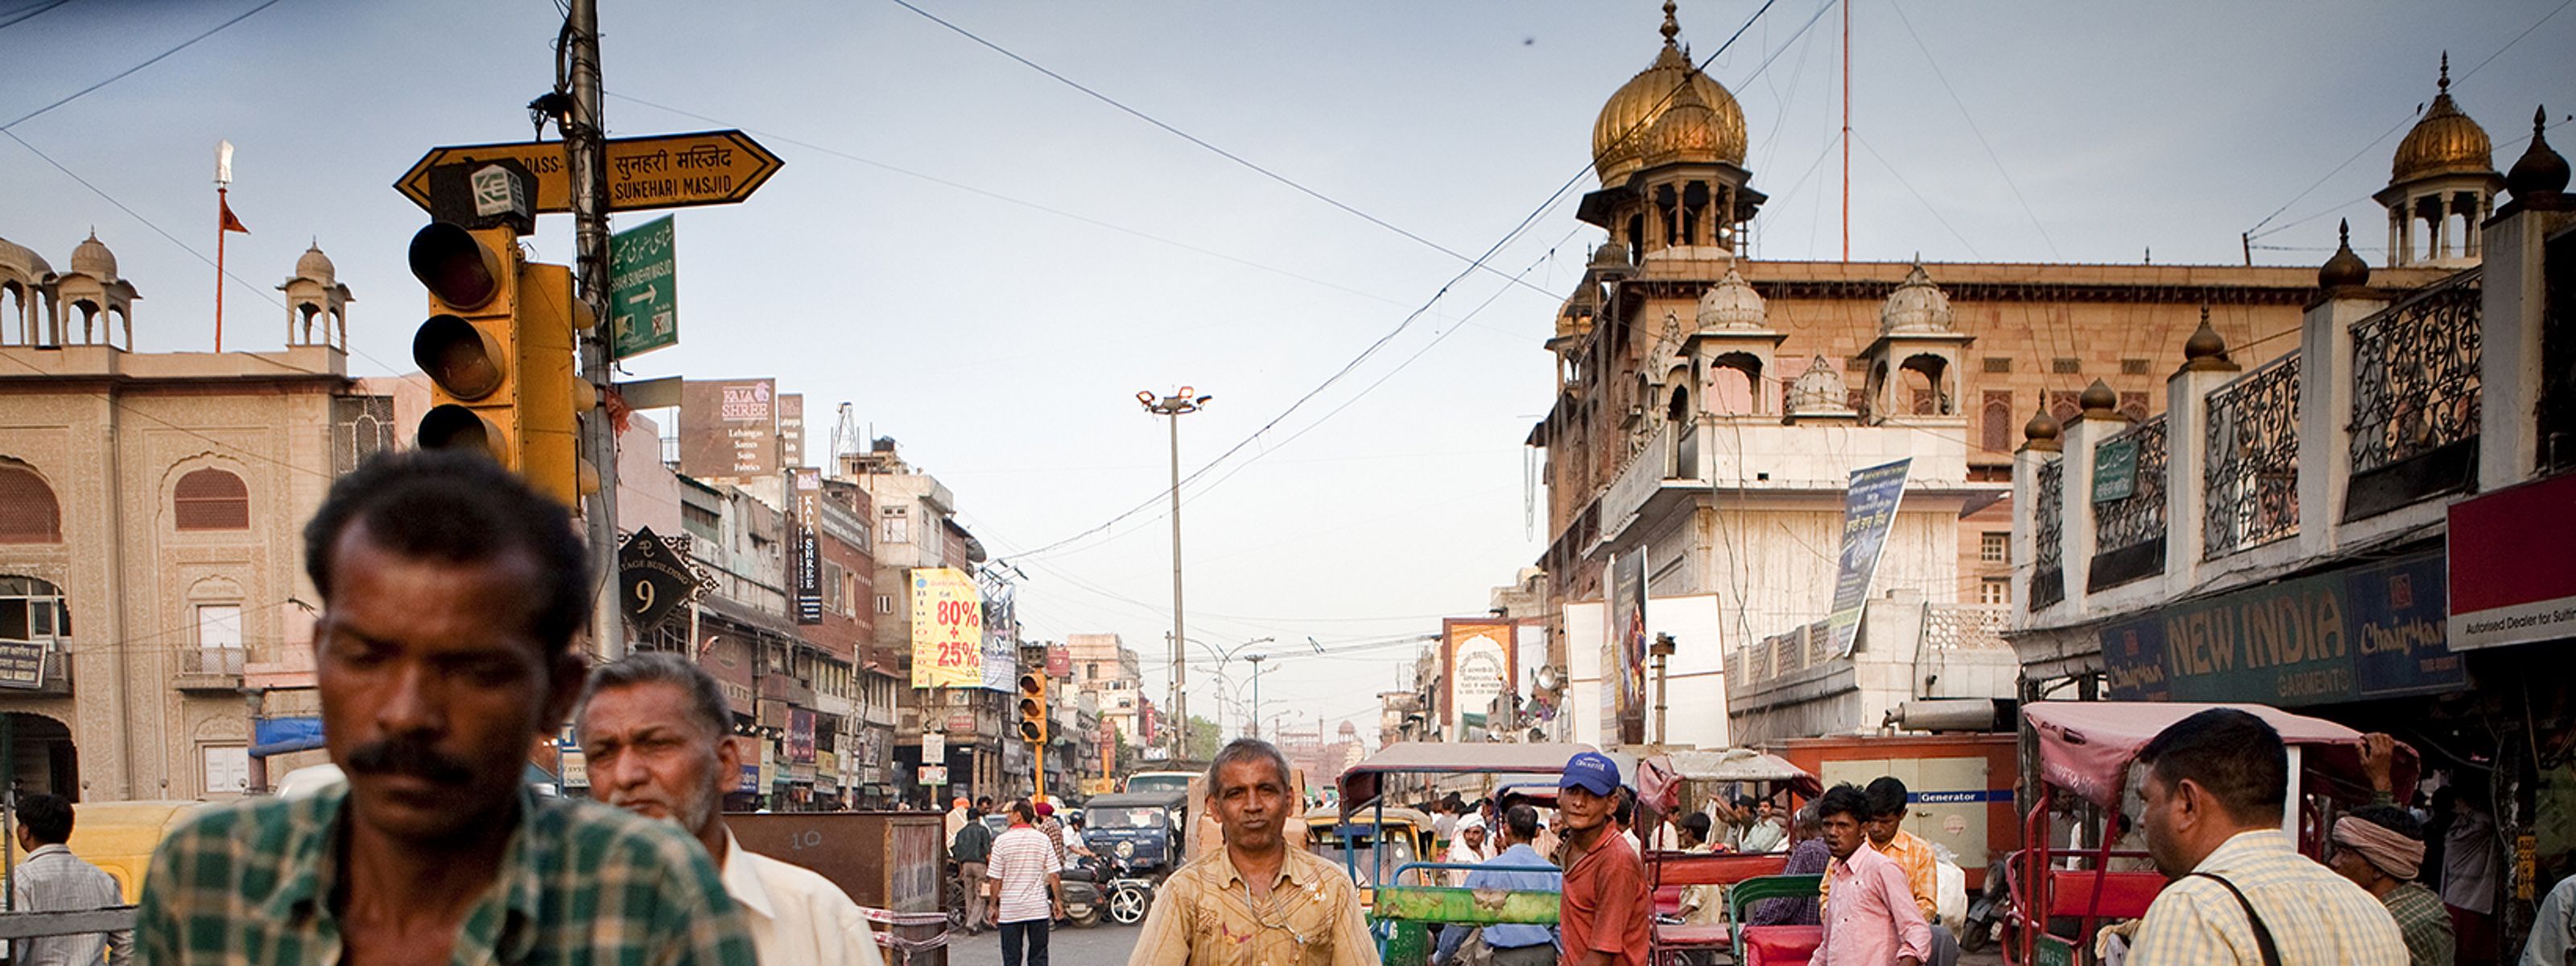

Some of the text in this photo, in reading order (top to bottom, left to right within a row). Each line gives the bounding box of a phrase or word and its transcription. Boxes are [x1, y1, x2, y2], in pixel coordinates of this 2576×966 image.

[615, 149, 668, 180] सुनहरी
[615, 175, 732, 200] SUNEHARI MASJID
[722, 403, 768, 417] SHREE
[805, 495, 815, 535] KALA
[805, 538, 815, 589] SHREE
[635, 579, 655, 614] 9
[937, 600, 980, 628] 80%
[2465, 618, 2506, 635] Autorised
[2507, 614, 2537, 630] Dealer
[2538, 613, 2551, 625] for
[2166, 586, 2346, 678] NEW INDIA
[937, 641, 980, 668] 25%
[2277, 669, 2351, 698] GARMENTS
[1922, 793, 1976, 802] Generator
